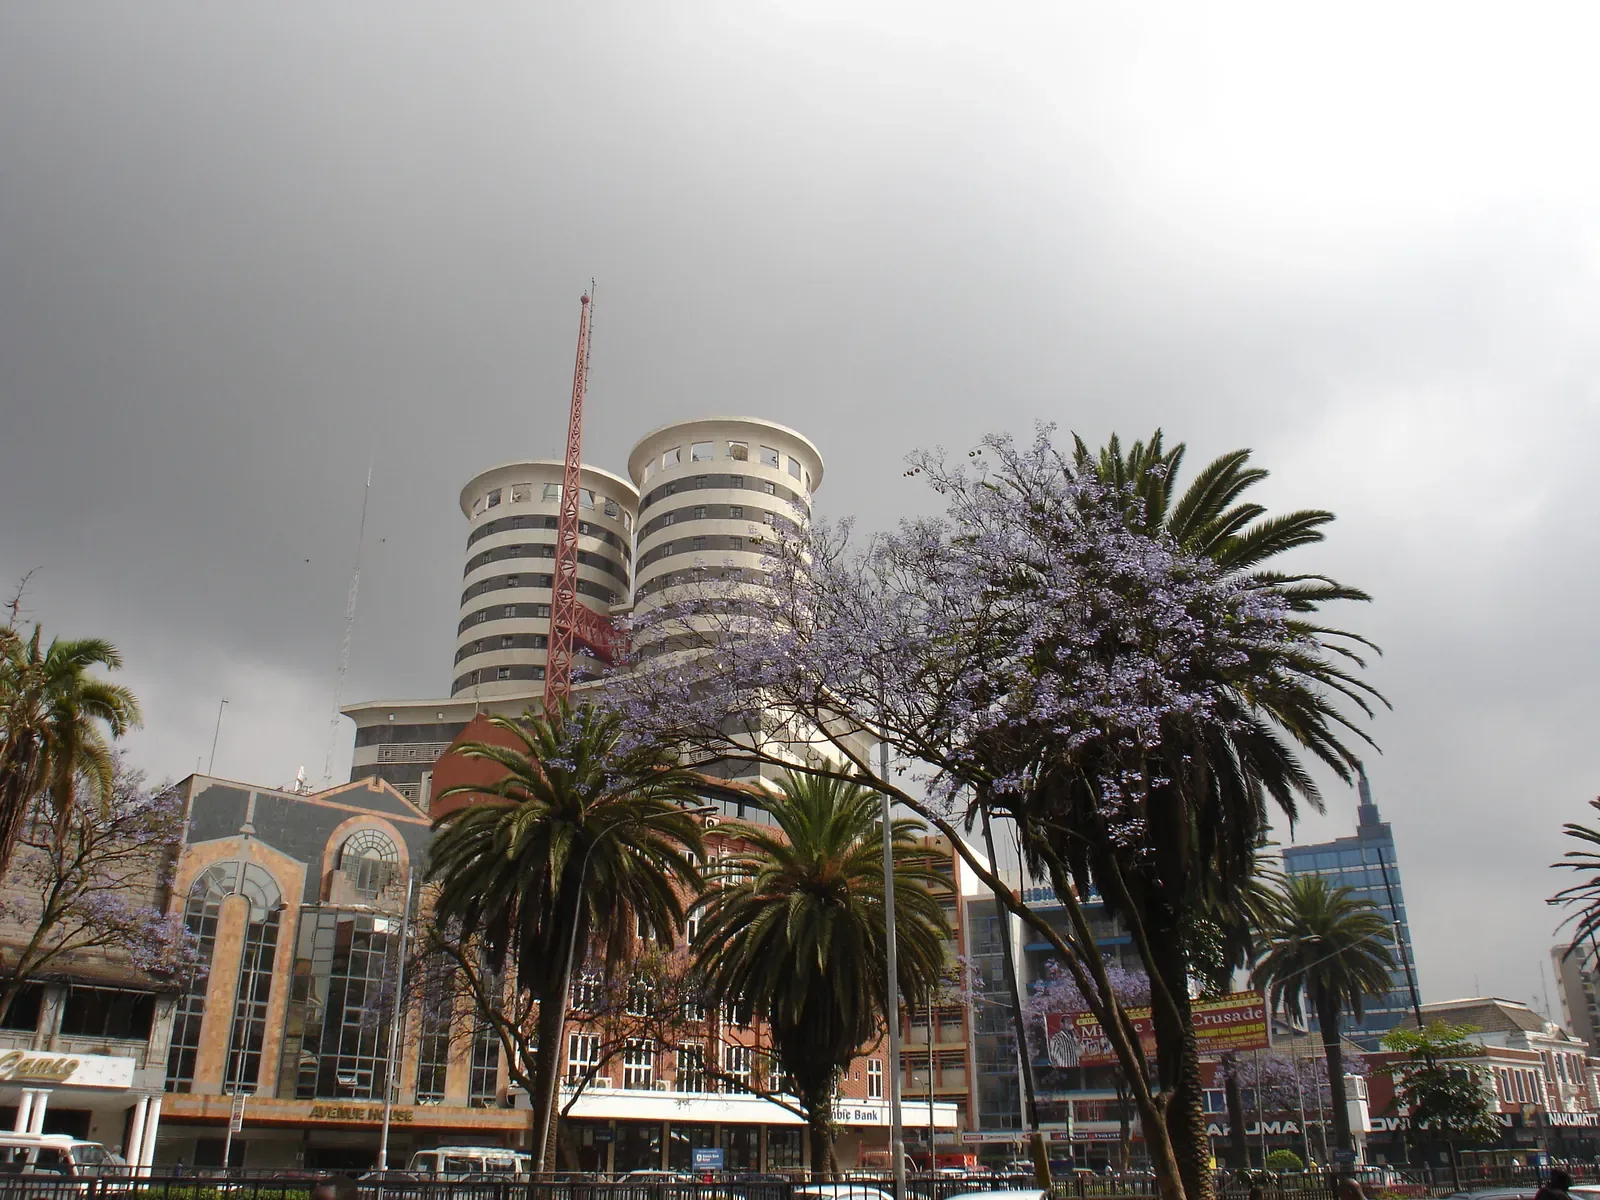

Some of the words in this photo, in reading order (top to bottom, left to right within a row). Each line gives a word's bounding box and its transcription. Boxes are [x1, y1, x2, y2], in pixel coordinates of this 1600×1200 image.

[1191, 1006, 1263, 1026] Crusade
[309, 1106, 367, 1120] AVENUE
[854, 1110, 878, 1121] Bank
[1549, 1113, 1598, 1126] NAKUMATT
